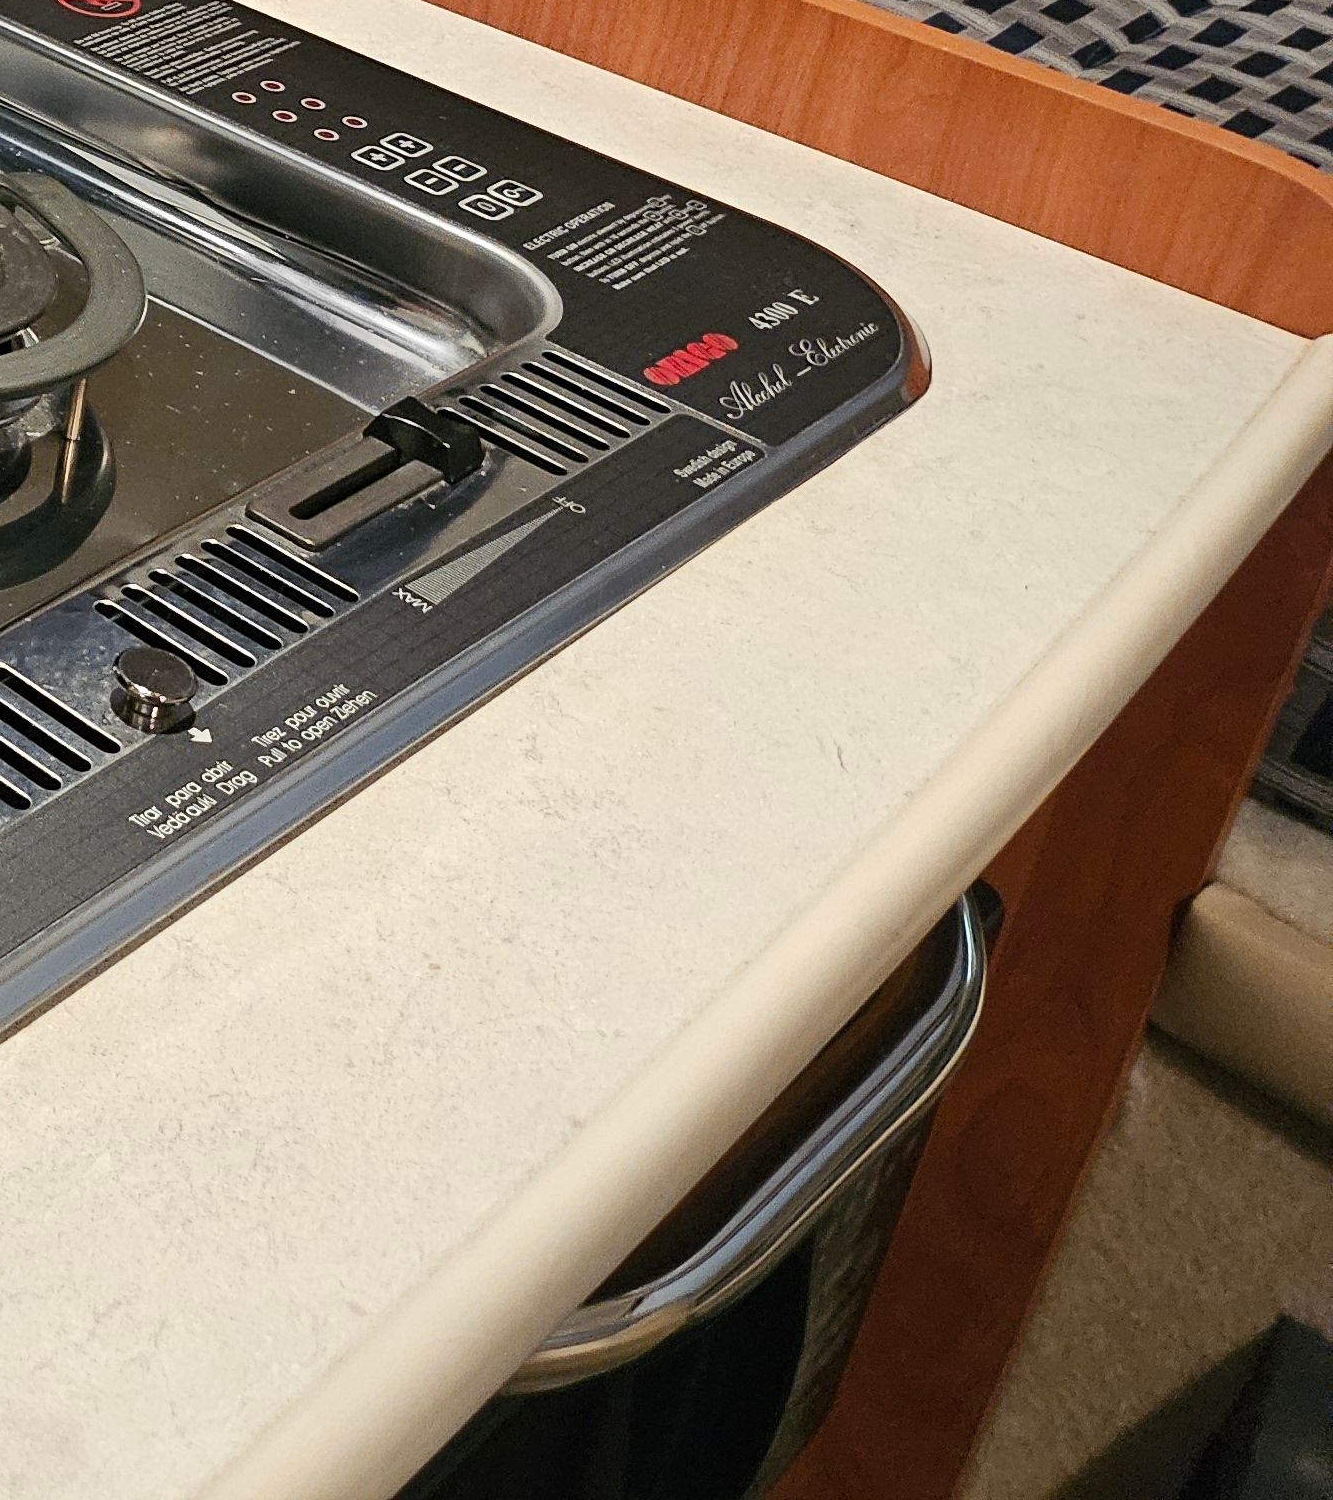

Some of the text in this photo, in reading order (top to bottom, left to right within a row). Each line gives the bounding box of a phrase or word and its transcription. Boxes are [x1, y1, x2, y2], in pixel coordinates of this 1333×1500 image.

[523, 223, 570, 251] ELECTRIC
[567, 201, 615, 231] OPERATION
[748, 302, 798, 331] 4300
[788, 289, 819, 306] E
[719, 365, 793, 419] Alcohol
[673, 447, 711, 478] Swedish
[693, 466, 722, 488] Made
[552, 496, 586, 514] OFF
[392, 587, 433, 614] MAX
[251, 682, 351, 748] Tirez pour ouvrir
[257, 688, 379, 768] Pull to open Ziehen
[128, 758, 233, 828] Tirar para abrir
[188, 794, 217, 818] auki
[215, 768, 259, 796] Drag
